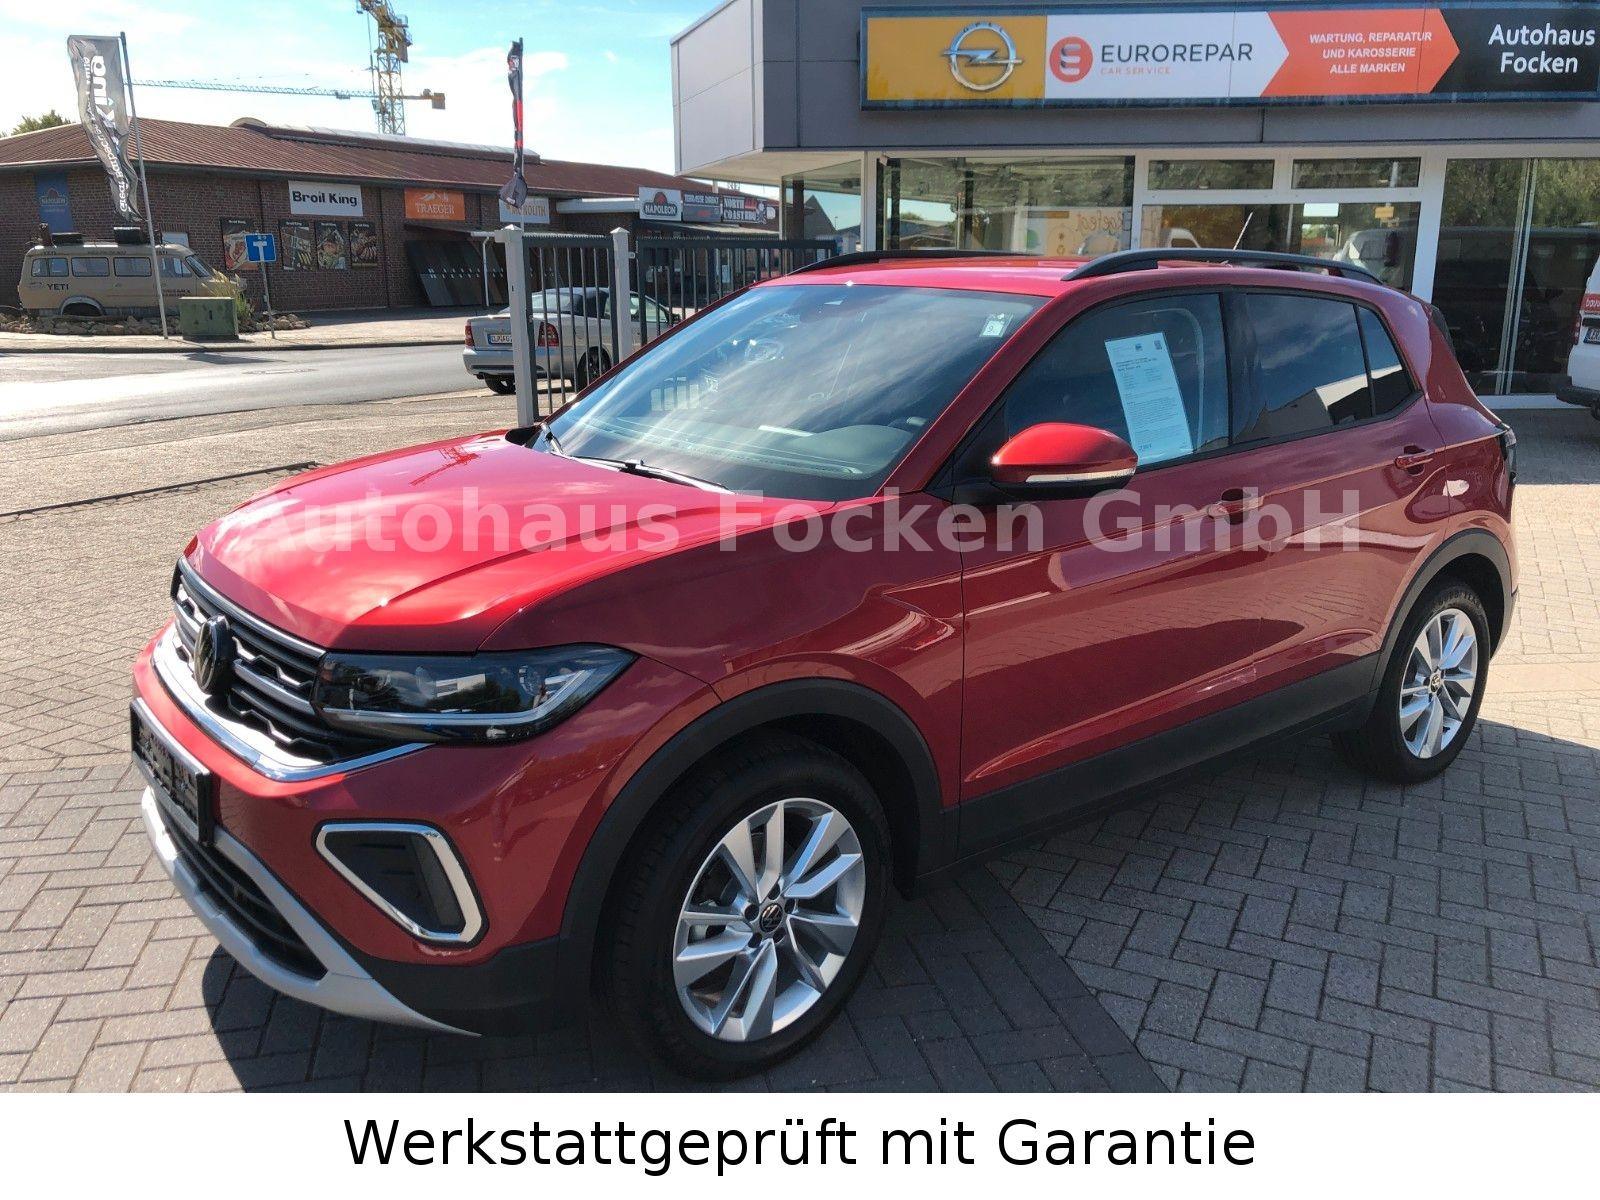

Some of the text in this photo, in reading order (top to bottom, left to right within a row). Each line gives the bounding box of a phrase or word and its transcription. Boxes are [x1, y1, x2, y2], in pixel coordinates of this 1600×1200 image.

[1309, 31, 1432, 44] WARTUNG, REPARATUR
[1488, 22, 1596, 46] Autohaus
[1101, 43, 1253, 63] EUROREPAR
[1322, 47, 1416, 59] UND KAROSSERIE
[1330, 62, 1406, 74] ALLE MARKEN
[1500, 50, 1578, 73] Focken
[1100, 66, 1171, 75] CAR SERVICE
[292, 190, 358, 207] Broil King
[415, 202, 455, 215] TRAEGER
[644, 205, 677, 215] NAPOLEON
[47, 283, 69, 291] YETI
